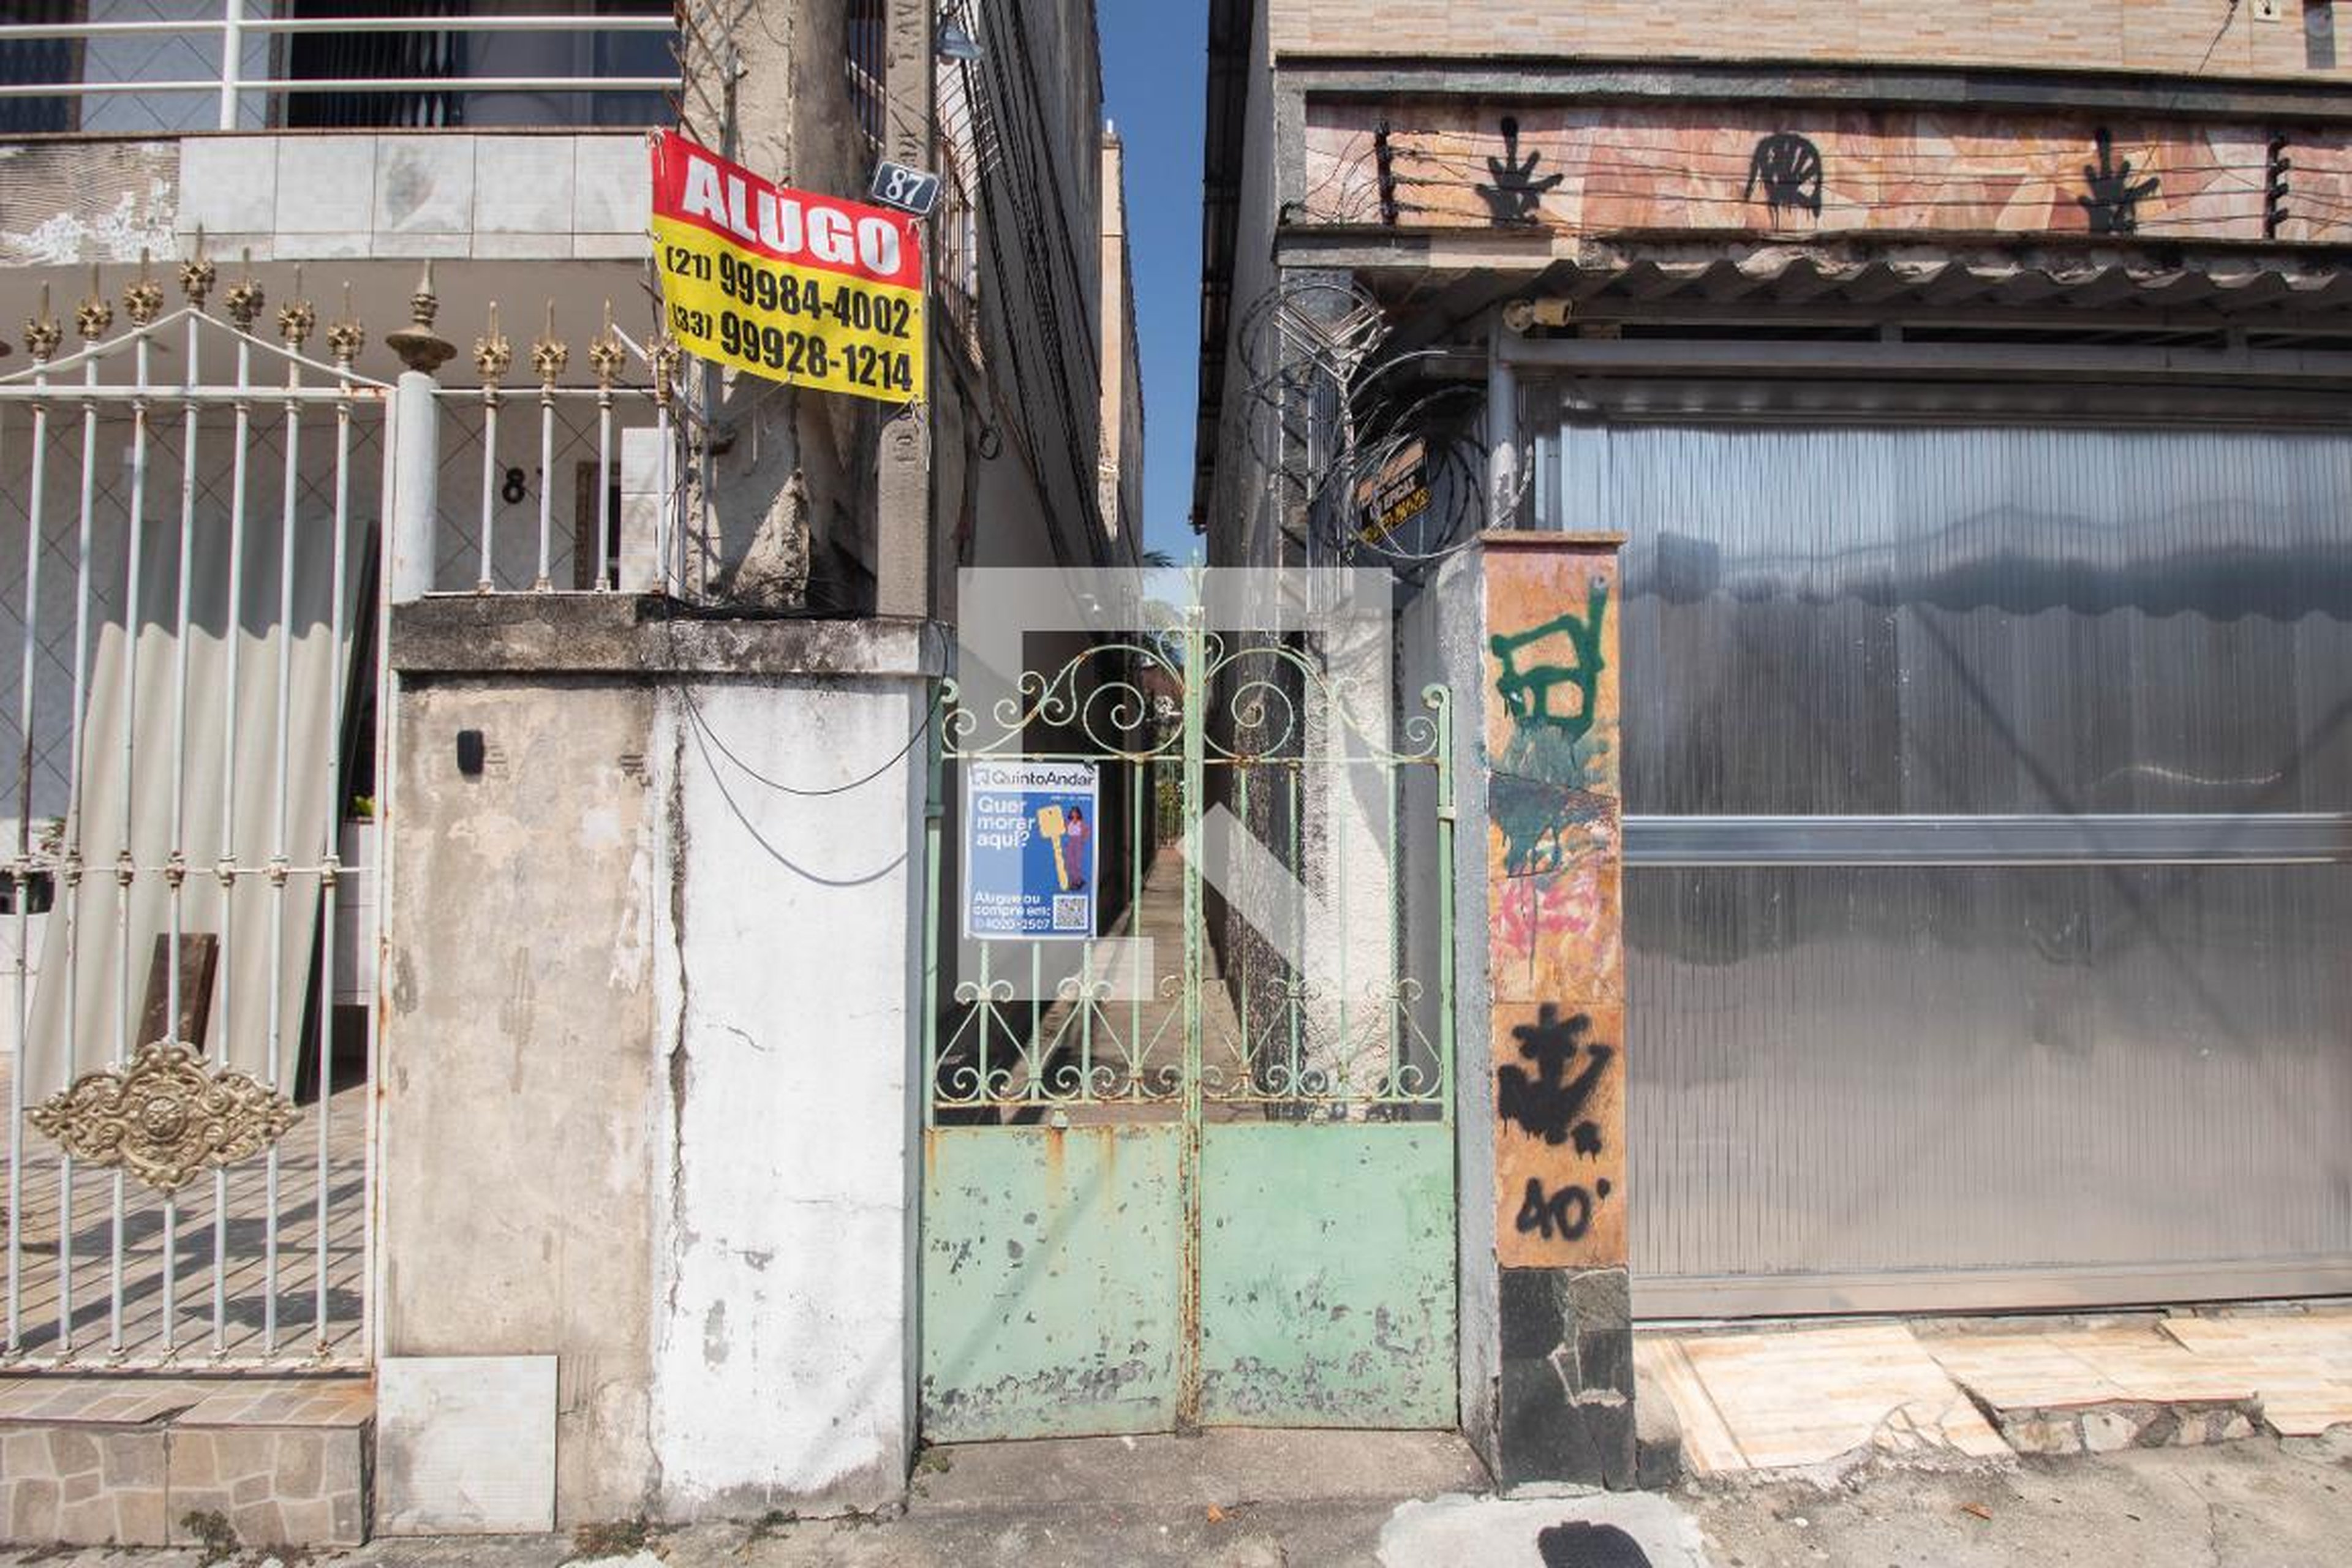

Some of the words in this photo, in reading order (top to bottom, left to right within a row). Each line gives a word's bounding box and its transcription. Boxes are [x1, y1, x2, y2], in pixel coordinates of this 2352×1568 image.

[885, 169, 925, 205] 87
[682, 156, 901, 276] ALUGO
[666, 245, 711, 282] (21)
[719, 251, 911, 339] 99984-4002
[673, 303, 713, 341] (33)
[720, 311, 914, 392] 99928-1214
[991, 771, 1094, 787] QuintoAndar
[976, 816, 1036, 830] morar
[976, 831, 1030, 850] aqui?
